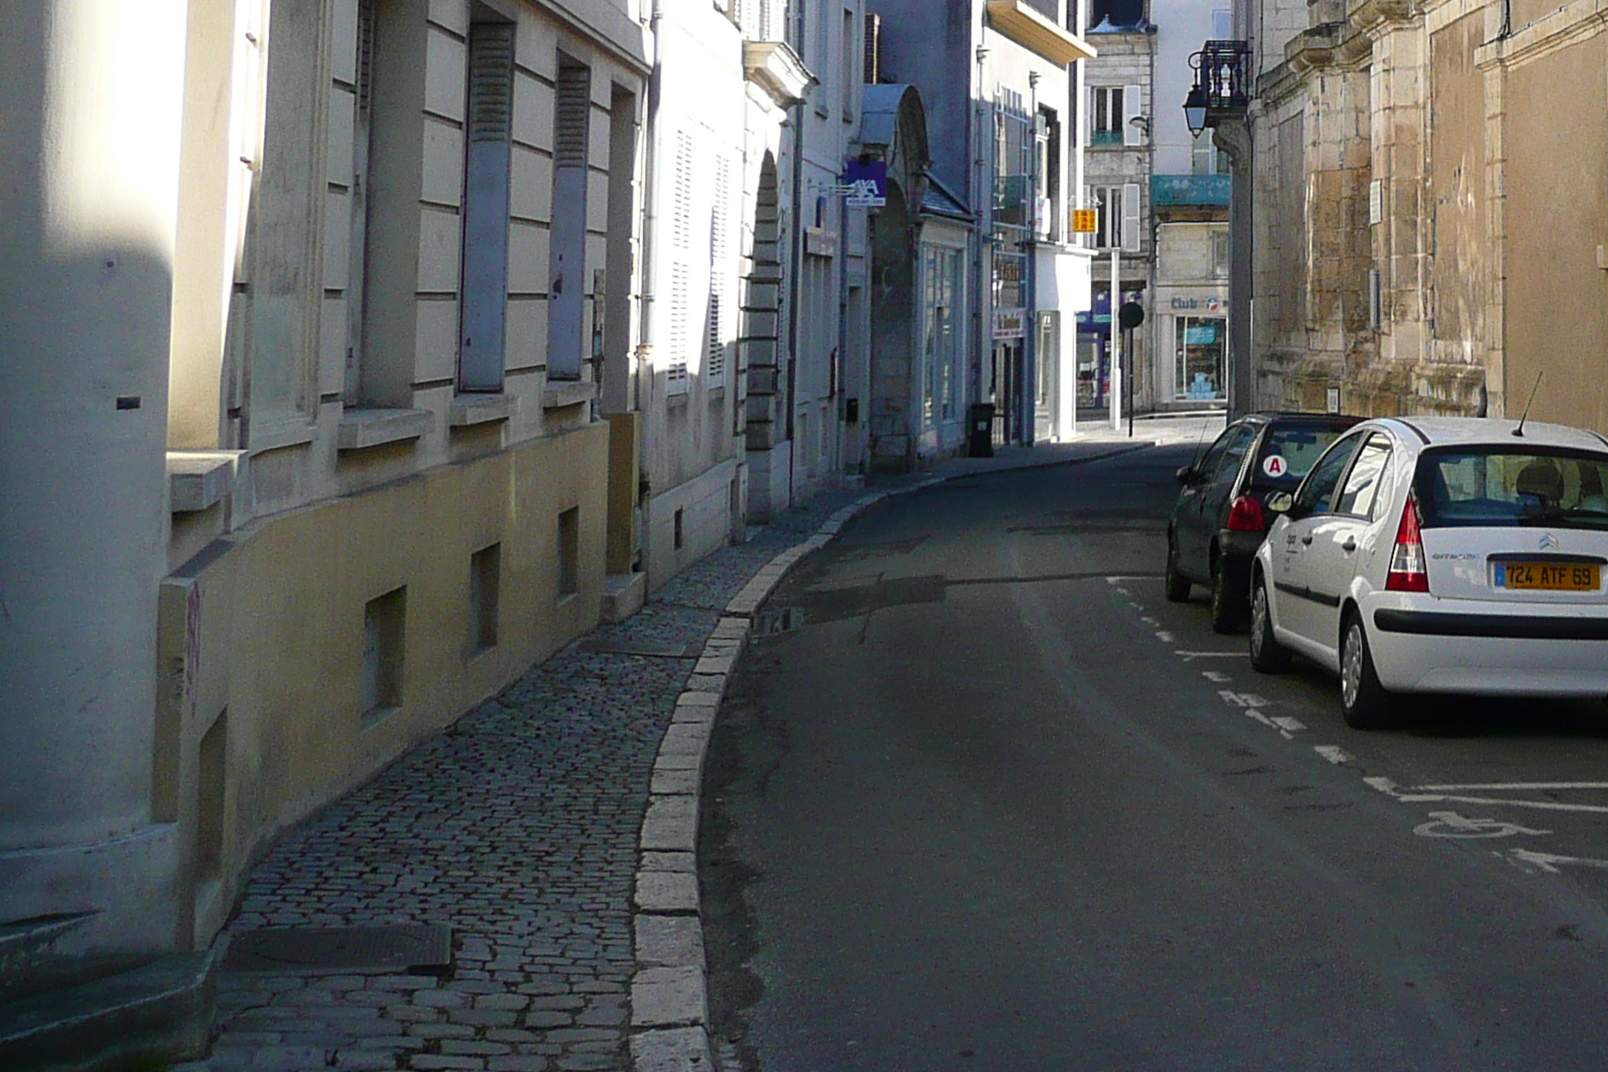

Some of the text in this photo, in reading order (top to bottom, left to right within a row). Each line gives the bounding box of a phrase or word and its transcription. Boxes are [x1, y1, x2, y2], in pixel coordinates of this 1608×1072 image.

[1171, 297, 1198, 309] Club
[1269, 458, 1281, 473] A
[1506, 565, 1591, 585] 724 ATF 69
